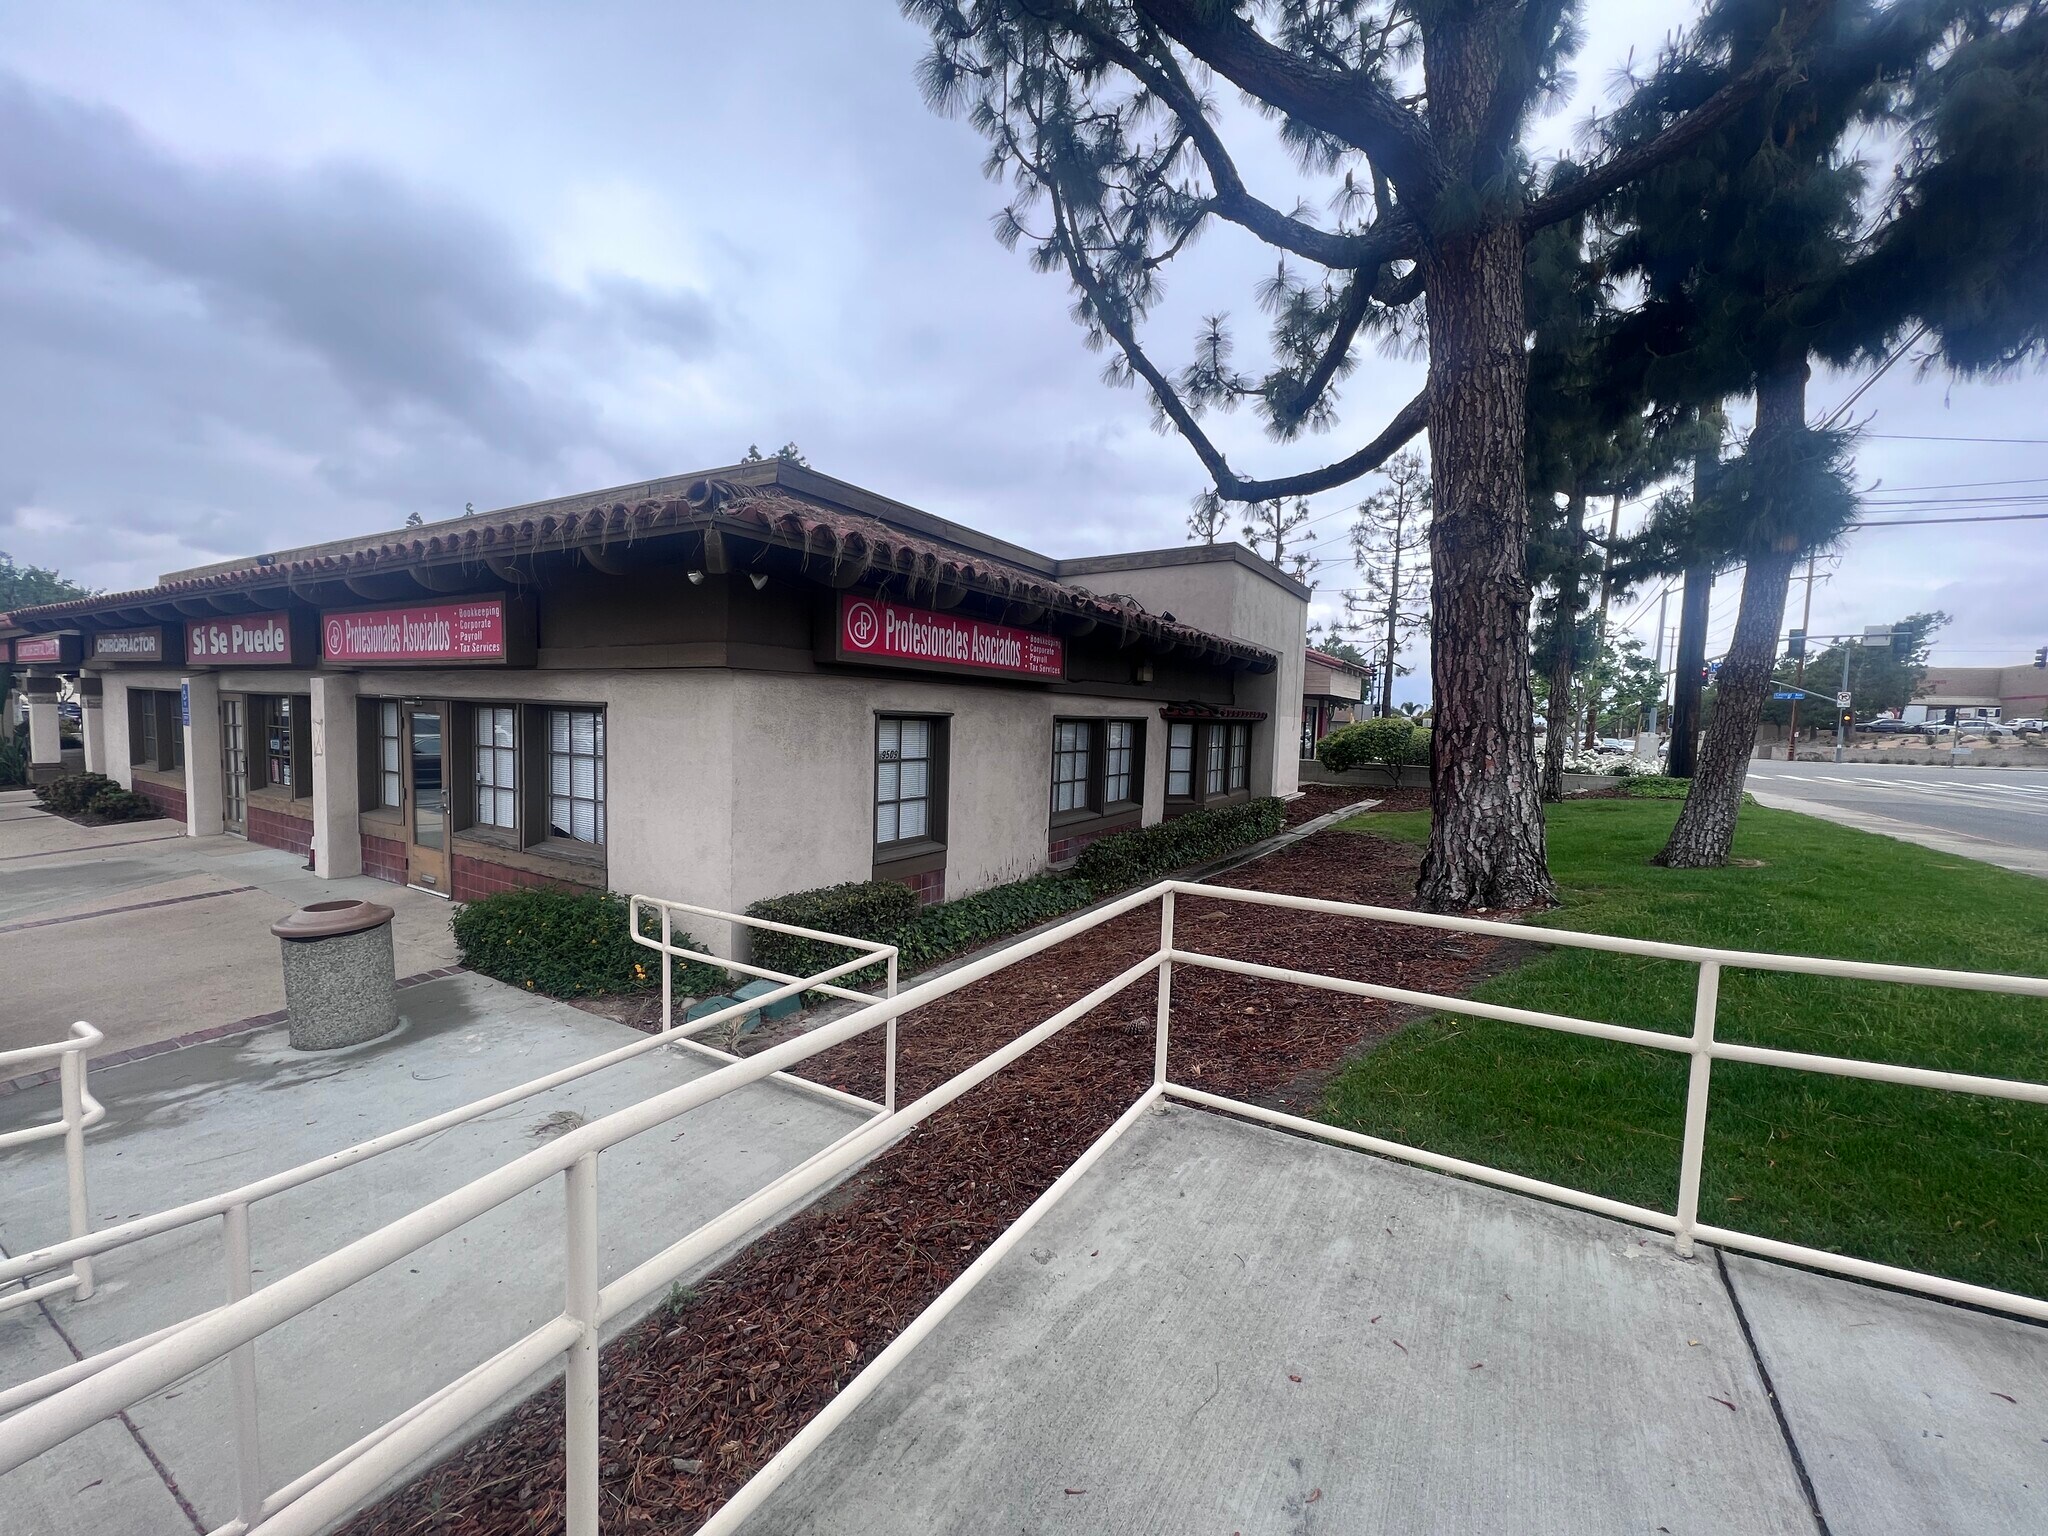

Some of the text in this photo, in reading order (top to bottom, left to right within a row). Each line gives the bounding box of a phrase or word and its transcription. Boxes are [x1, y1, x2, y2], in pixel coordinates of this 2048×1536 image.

[459, 606, 500, 618] Bookkeeping
[460, 618, 491, 631] Corporate
[209, 626, 228, 655] Se
[231, 619, 285, 654] Puede
[345, 613, 450, 654] Profesionales Asociados
[460, 630, 483, 642] Payroll
[885, 608, 1021, 668] Profesionales Asociados
[460, 642, 500, 653] Tax Services
[1029, 643, 1055, 656] Corporate
[1029, 653, 1048, 664] Payroll
[1029, 662, 1061, 674] Tax Services
